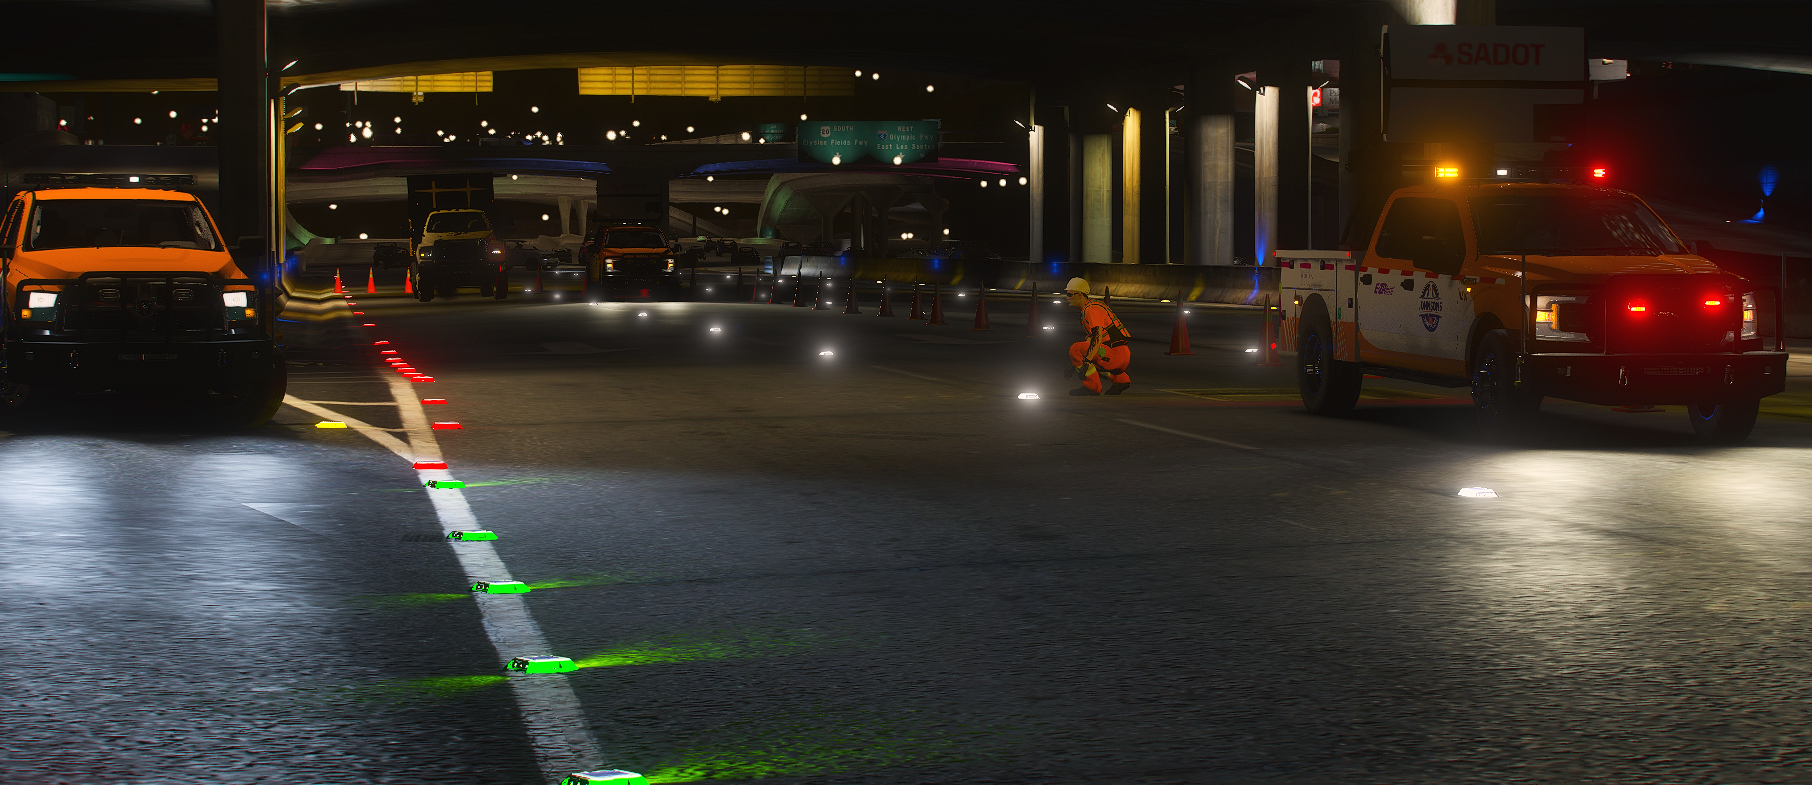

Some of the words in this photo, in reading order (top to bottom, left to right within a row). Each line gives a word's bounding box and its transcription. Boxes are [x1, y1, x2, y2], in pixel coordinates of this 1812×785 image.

[1457, 42, 1545, 66] SADOT
[889, 133, 916, 141] Olympic
[919, 133, 934, 141] Fwy
[802, 139, 828, 147] Elysian
[854, 139, 868, 147] Fwy
